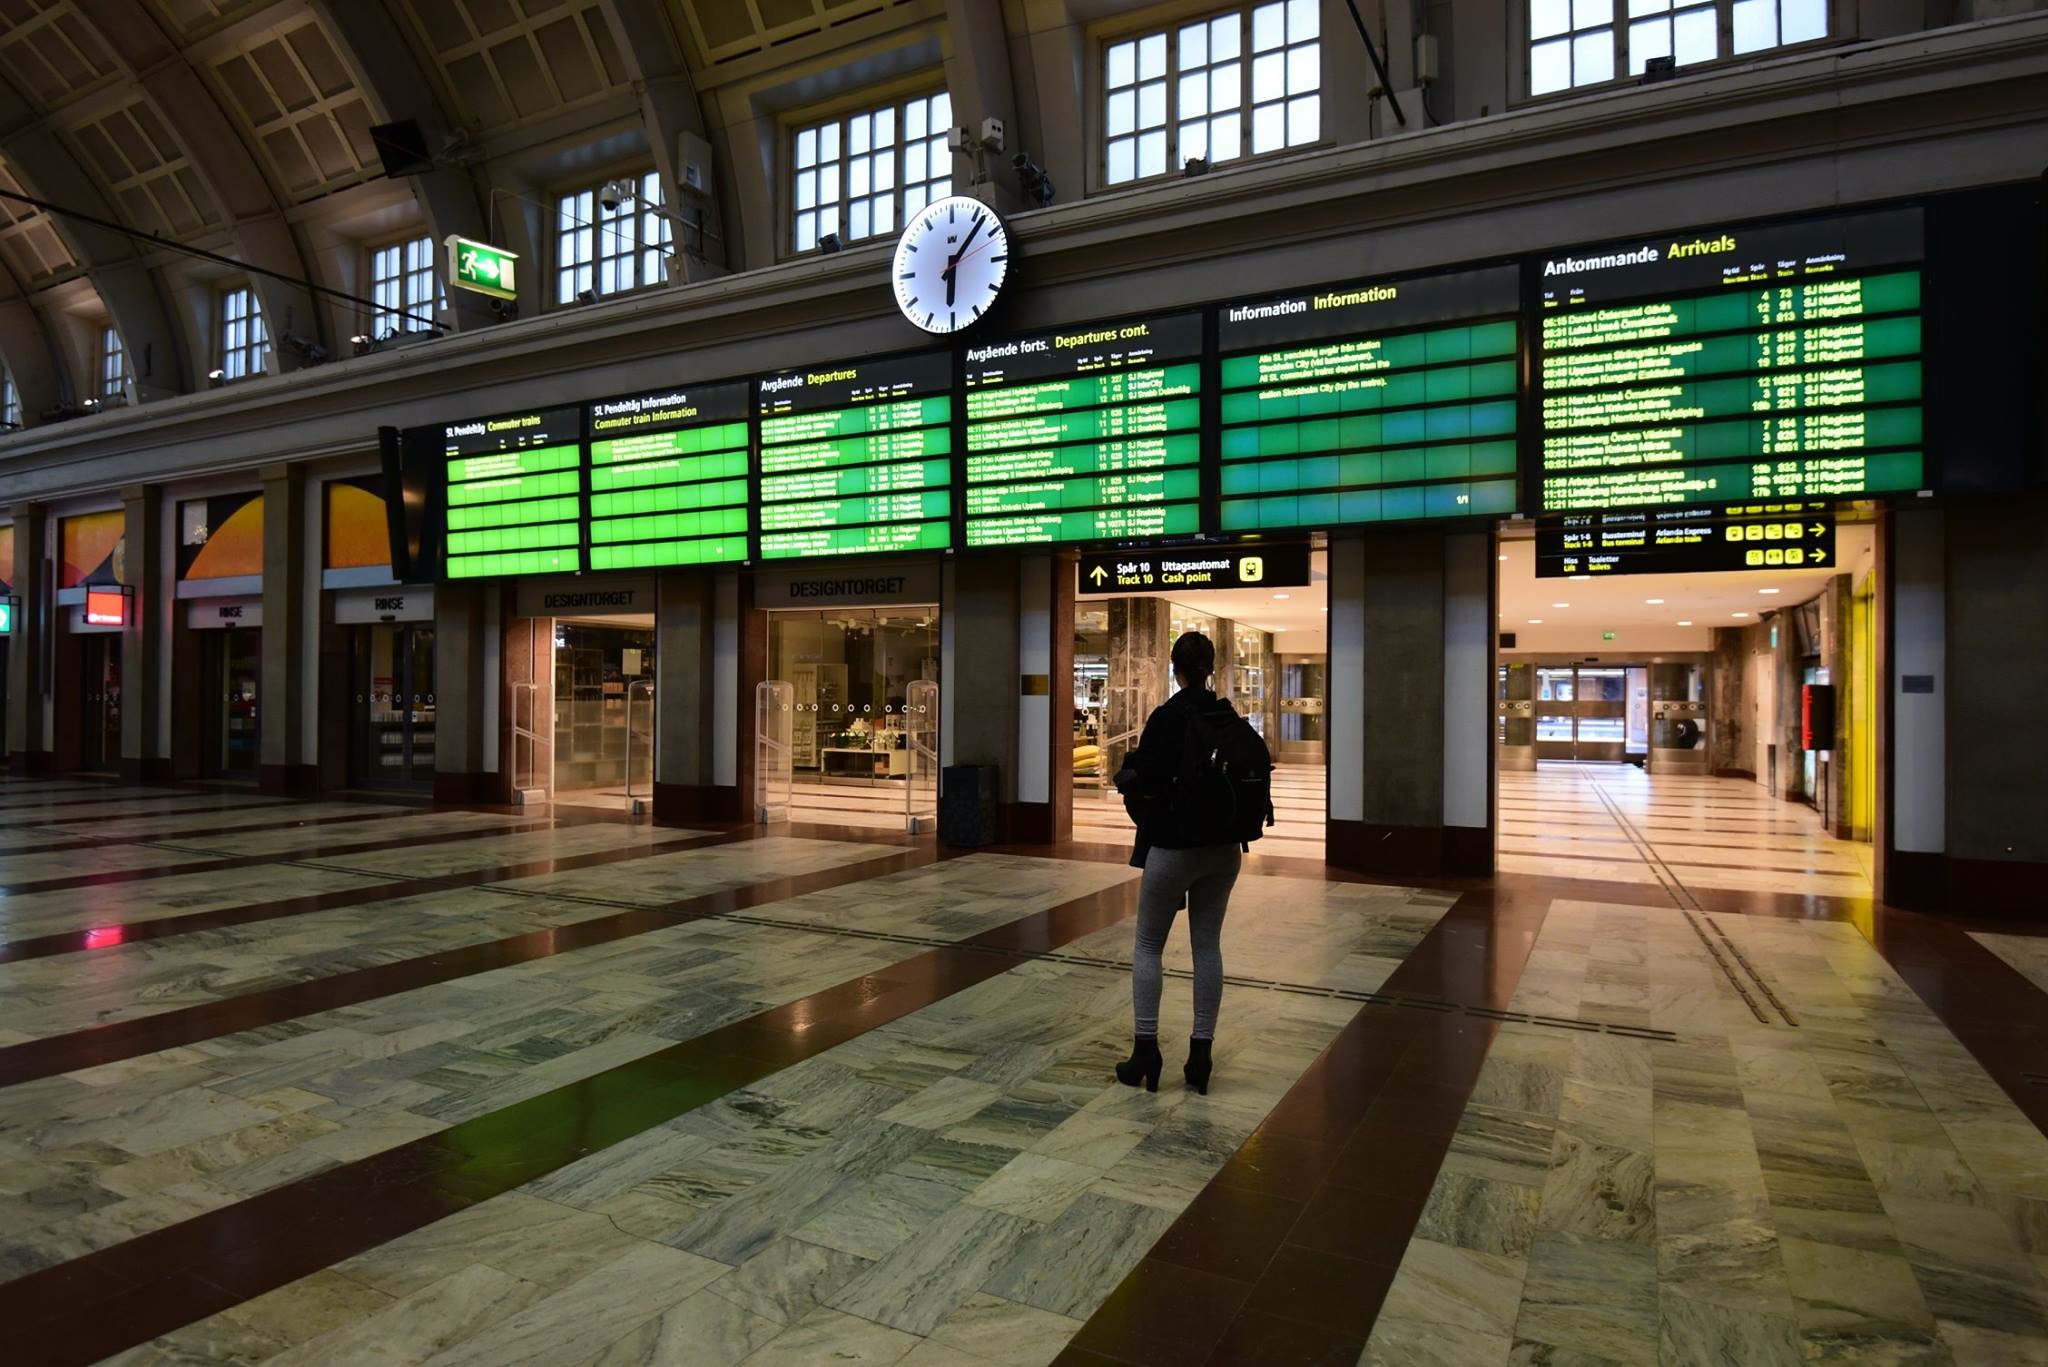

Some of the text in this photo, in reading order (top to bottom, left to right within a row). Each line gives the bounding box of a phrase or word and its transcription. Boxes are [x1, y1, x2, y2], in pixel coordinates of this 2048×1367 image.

[1544, 235, 1736, 276] Ankommande Arrivals
[1761, 291, 1770, 301] 4
[1803, 285, 1818, 296] SJ
[1230, 287, 1396, 322] Information Information
[1757, 302, 1770, 313] 12
[1803, 296, 1818, 308] SJ
[1762, 314, 1770, 324] 3
[1803, 308, 1818, 320] SJ
[1804, 328, 1818, 340] SJ
[967, 324, 1149, 362] Avgående forts. Departures cont.
[1762, 345, 1771, 356] 3
[1803, 340, 1819, 352] SJ
[1803, 352, 1818, 363] SJ
[761, 370, 856, 392] Avgående Departures
[1804, 372, 1819, 383] SJ
[1804, 384, 1819, 395] SJ
[594, 407, 603, 416] SL
[642, 394, 686, 409] Information
[1804, 396, 1819, 407] SJ
[594, 407, 696, 430] Commuter train Information
[1804, 416, 1819, 427] SJ
[1804, 428, 1819, 439] SJ
[1804, 440, 1819, 450] SJ
[1804, 460, 1819, 471] SJ
[1804, 472, 1819, 483] SJ
[1804, 484, 1819, 494] SJ
[1564, 534, 1579, 542] Spår
[1602, 530, 1646, 540] Bussterminal
[1656, 528, 1683, 537] Arlanda
[1685, 528, 1712, 536] Express
[1616, 538, 1644, 546] terminal
[1656, 536, 1683, 544] Arlanda
[1117, 559, 1230, 574] Spår 10 Uttagsautomat
[1118, 572, 1211, 585] Track 10 Cash point
[790, 577, 905, 597] DESIGNTORGET
[545, 590, 634, 609] DESIGNTORGET
